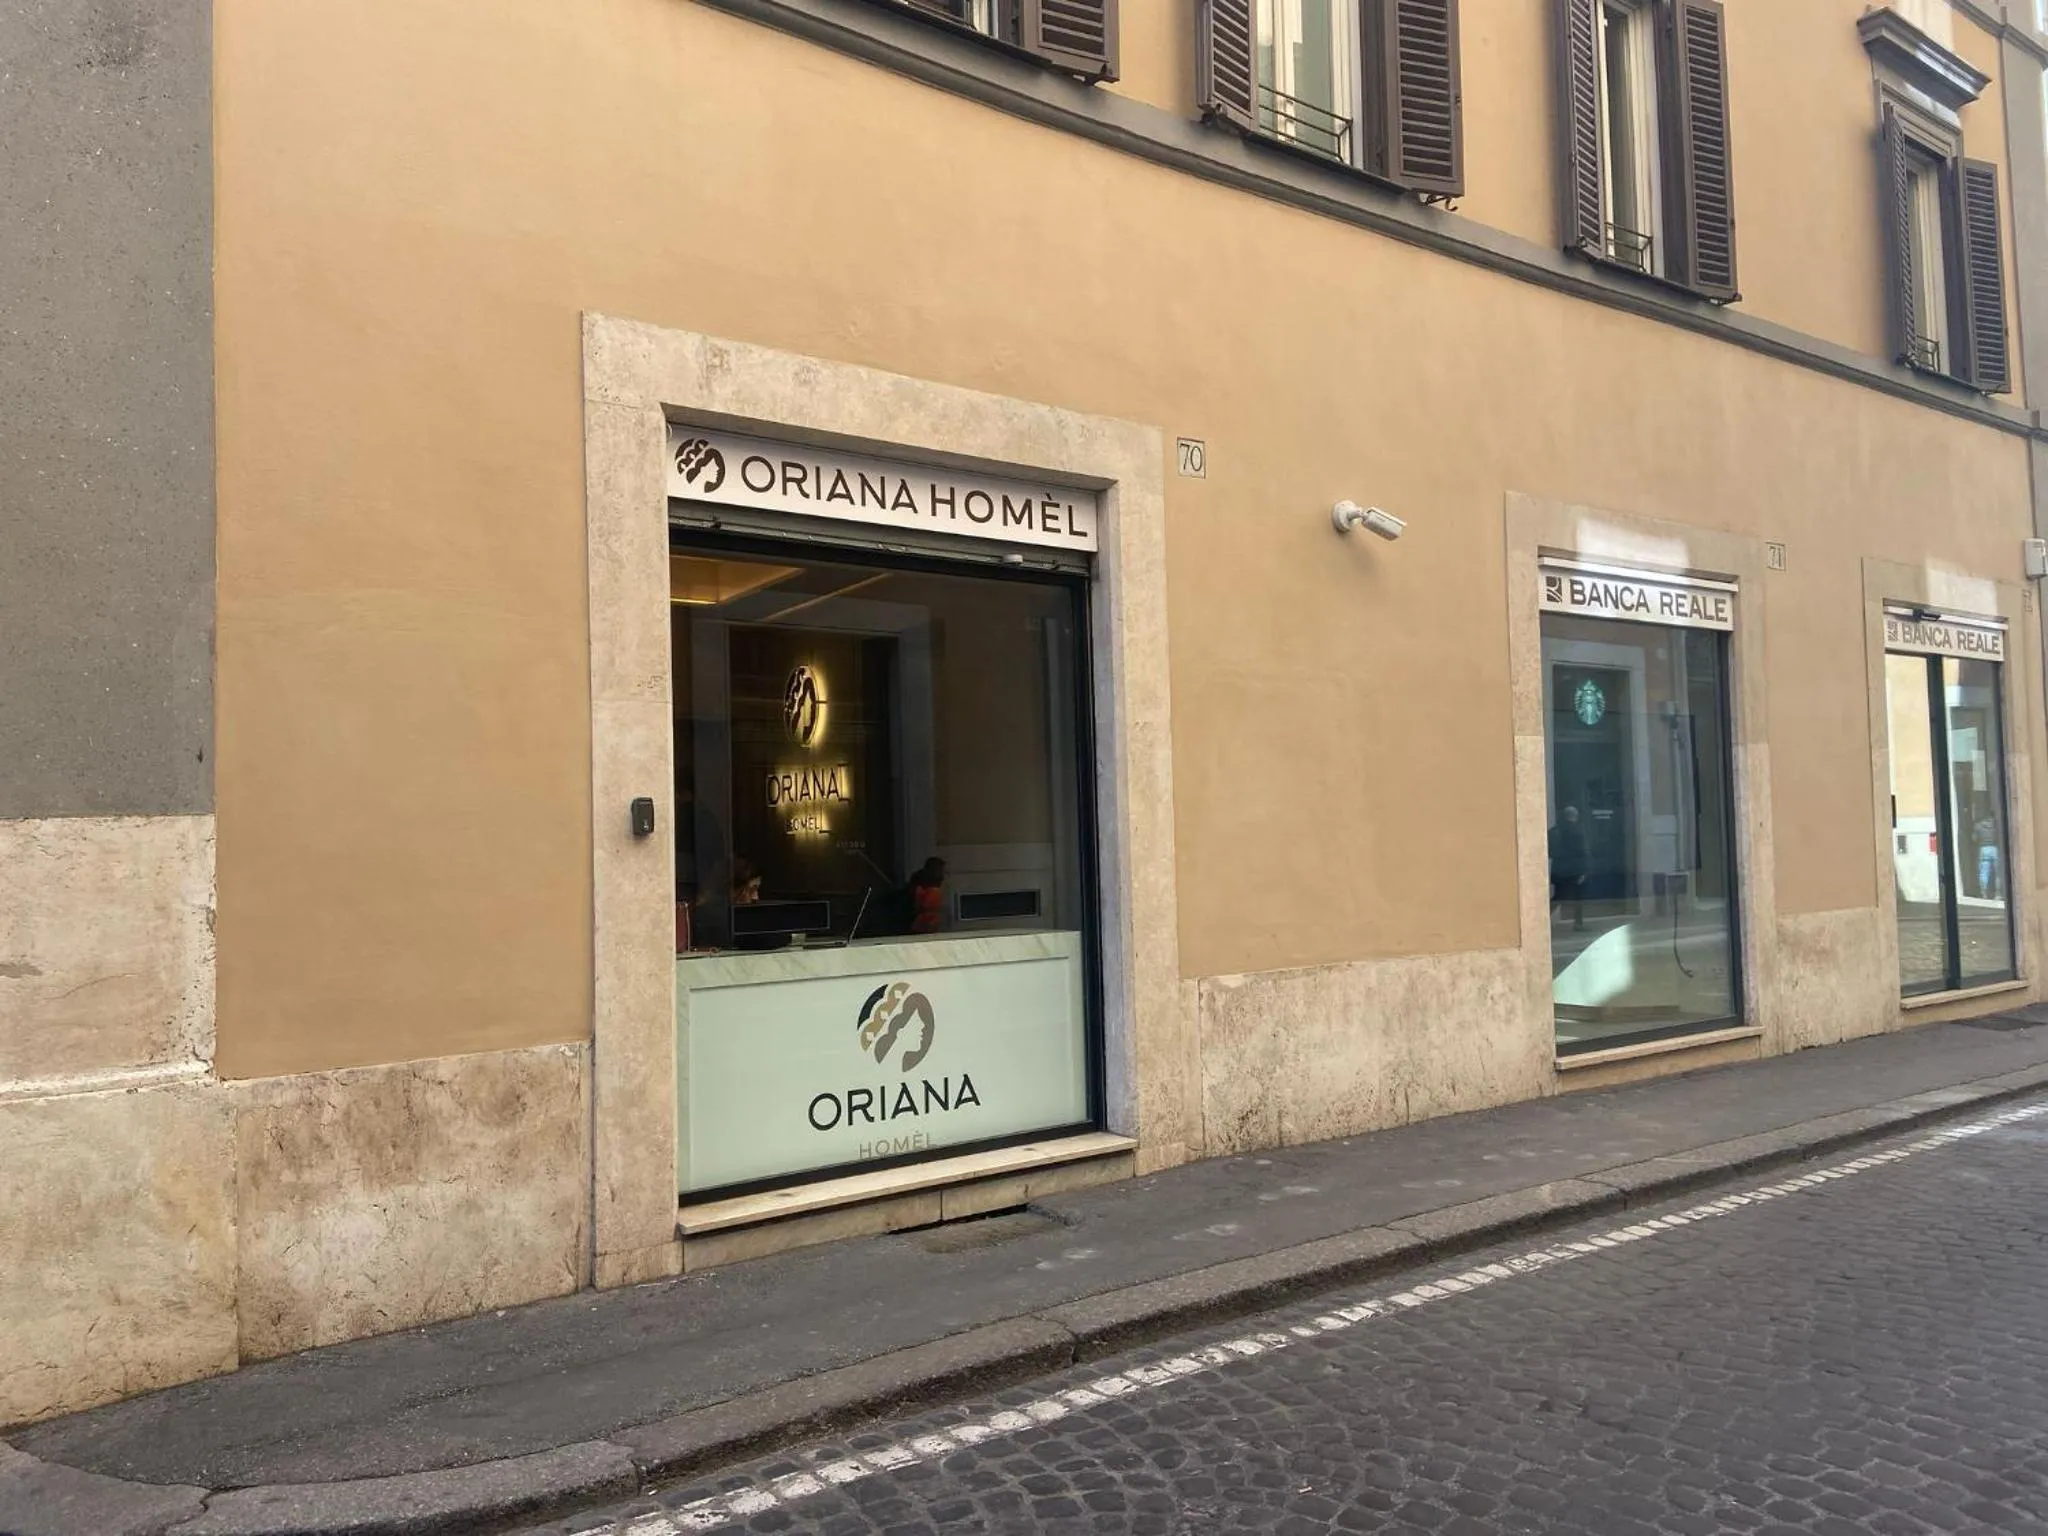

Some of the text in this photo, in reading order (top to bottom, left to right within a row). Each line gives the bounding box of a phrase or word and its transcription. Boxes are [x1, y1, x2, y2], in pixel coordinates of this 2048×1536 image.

[1179, 443, 1203, 472] 70
[741, 455, 1088, 537] ORIANA HOMÈL
[1769, 545, 1782, 567] 71
[1569, 578, 1728, 623] BANCA REALE
[1901, 622, 2001, 654] BANCA REALE
[766, 767, 839, 807] ORIANA
[808, 1073, 981, 1131] ORIANA
